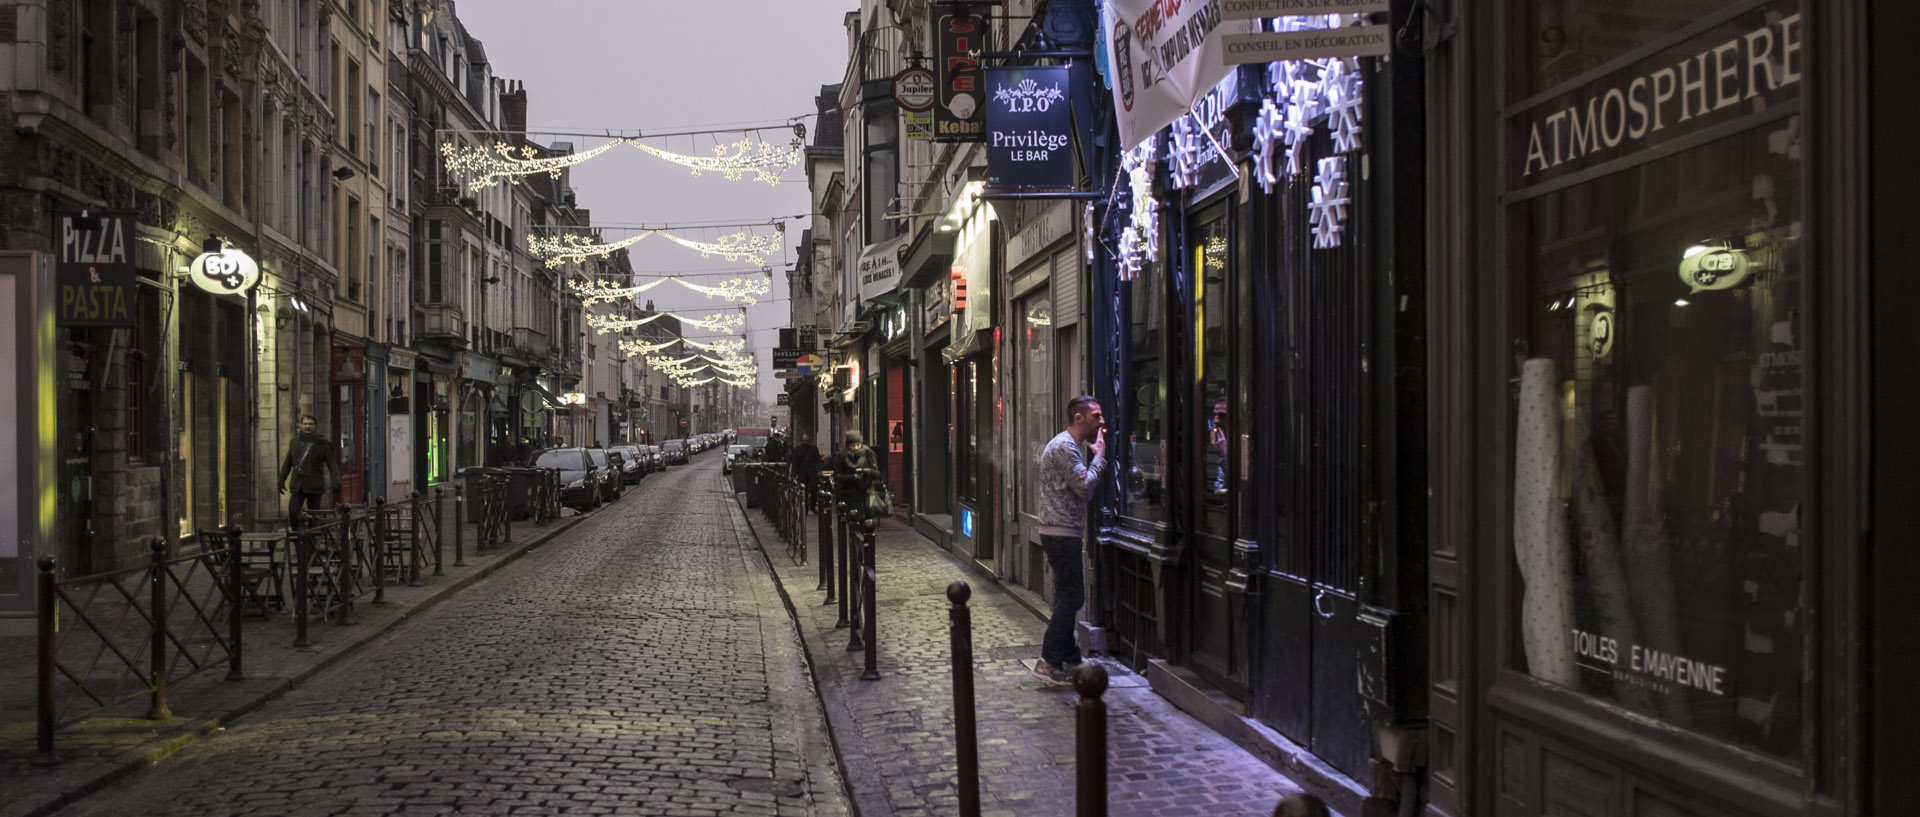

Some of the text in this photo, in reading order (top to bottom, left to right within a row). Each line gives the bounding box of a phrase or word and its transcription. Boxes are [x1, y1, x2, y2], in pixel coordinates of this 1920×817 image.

[1225, 0, 1303, 12] CONFECTION
[1307, 0, 1331, 8] SUR
[1160, 25, 1190, 73] EMPLOIS
[1228, 34, 1385, 54] CONSEIL EN DÉCORATION
[901, 85, 935, 95] Jupiler
[1522, 13, 1802, 177] ATMOSPHERE
[939, 119, 985, 134] Keba
[992, 130, 1068, 151] Privilège
[1011, 151, 1049, 161] LE BAR
[63, 216, 127, 264] PIZZA
[90, 266, 101, 283] &
[62, 284, 128, 320] PASTA
[1572, 629, 1618, 664] TOILES
[1644, 648, 1727, 696] MAYENNE
